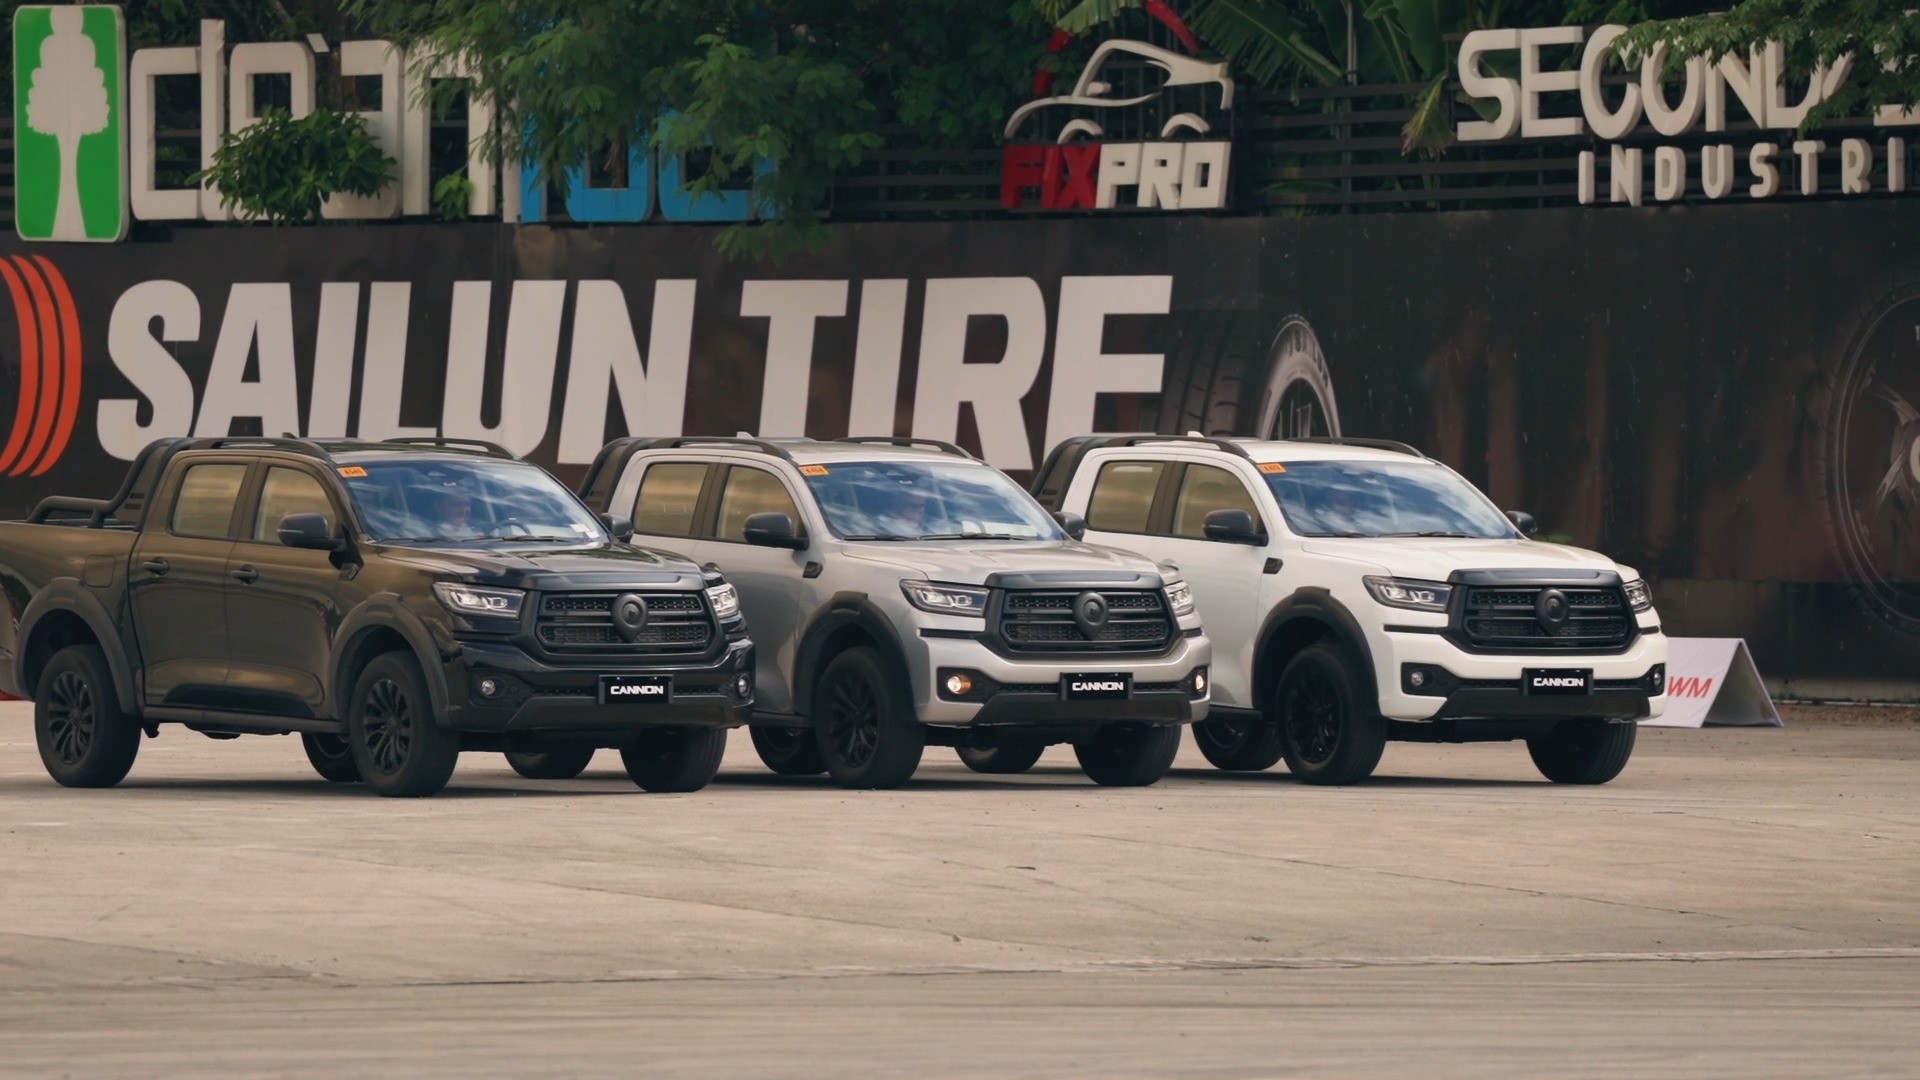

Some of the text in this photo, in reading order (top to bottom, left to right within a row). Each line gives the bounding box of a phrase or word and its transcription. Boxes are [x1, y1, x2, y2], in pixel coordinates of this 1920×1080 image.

[1000, 141, 1232, 209] FIXPRO
[1578, 136, 1905, 207] INDUSTRI
[97, 275, 1173, 471] SAILUN TIRE
[610, 685, 664, 695] CANNON
[1072, 682, 1124, 691] CANNON
[1533, 677, 1584, 687] CANNON
